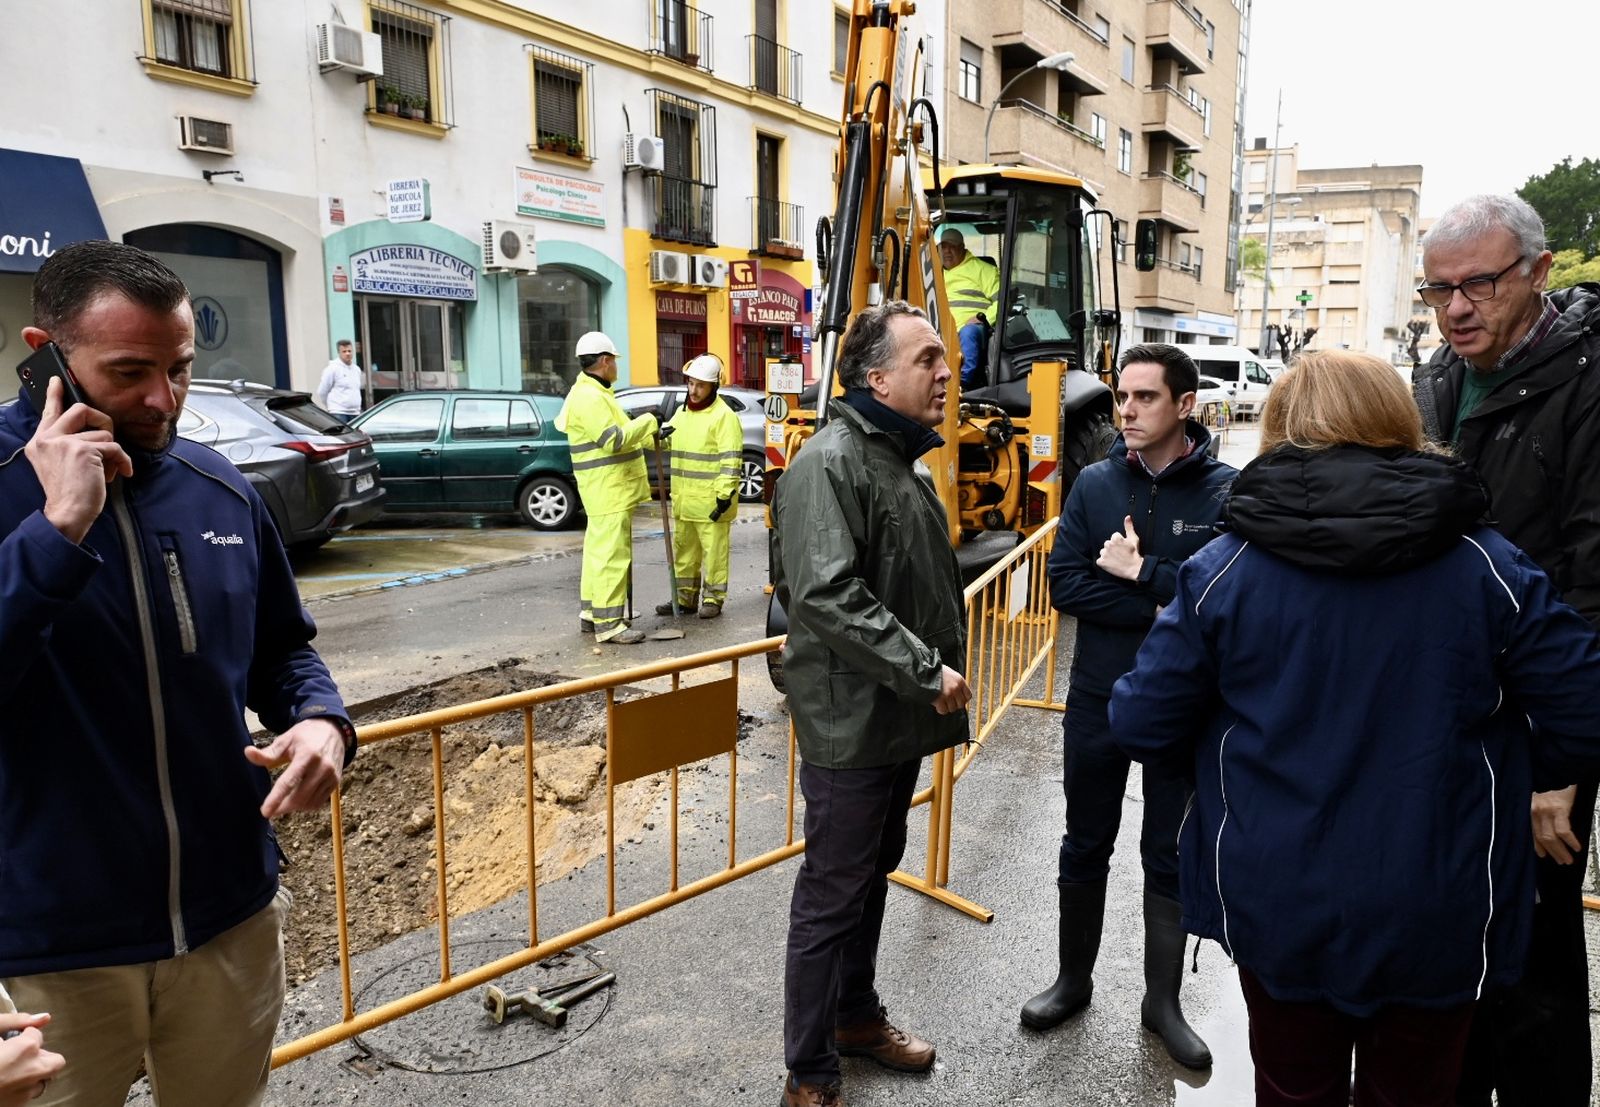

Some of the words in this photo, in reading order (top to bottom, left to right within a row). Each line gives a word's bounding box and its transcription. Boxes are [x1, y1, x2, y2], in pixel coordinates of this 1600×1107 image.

[390, 180, 420, 191] LIBRERIA
[519, 171, 554, 184] CONSULTA
[555, 179, 564, 187] DE
[390, 192, 422, 203] AGRICOLA
[391, 205, 400, 214] DE
[402, 203, 422, 213] JEREZ
[369, 247, 425, 263] LIBRERIA
[428, 250, 475, 281] TECNICA
[355, 280, 416, 294] PUBLICACIONES
[417, 285, 475, 299] ESPECIALIZADAS
[921, 250, 939, 336] JC
[657, 297, 674, 313] CAVA
[675, 299, 684, 314] DE
[685, 299, 706, 316] PUROS
[758, 309, 796, 321] TABACOS
[771, 367, 777, 376] E
[780, 367, 799, 377] 4384
[768, 397, 782, 418] 40
[210, 533, 244, 547] aqualia
